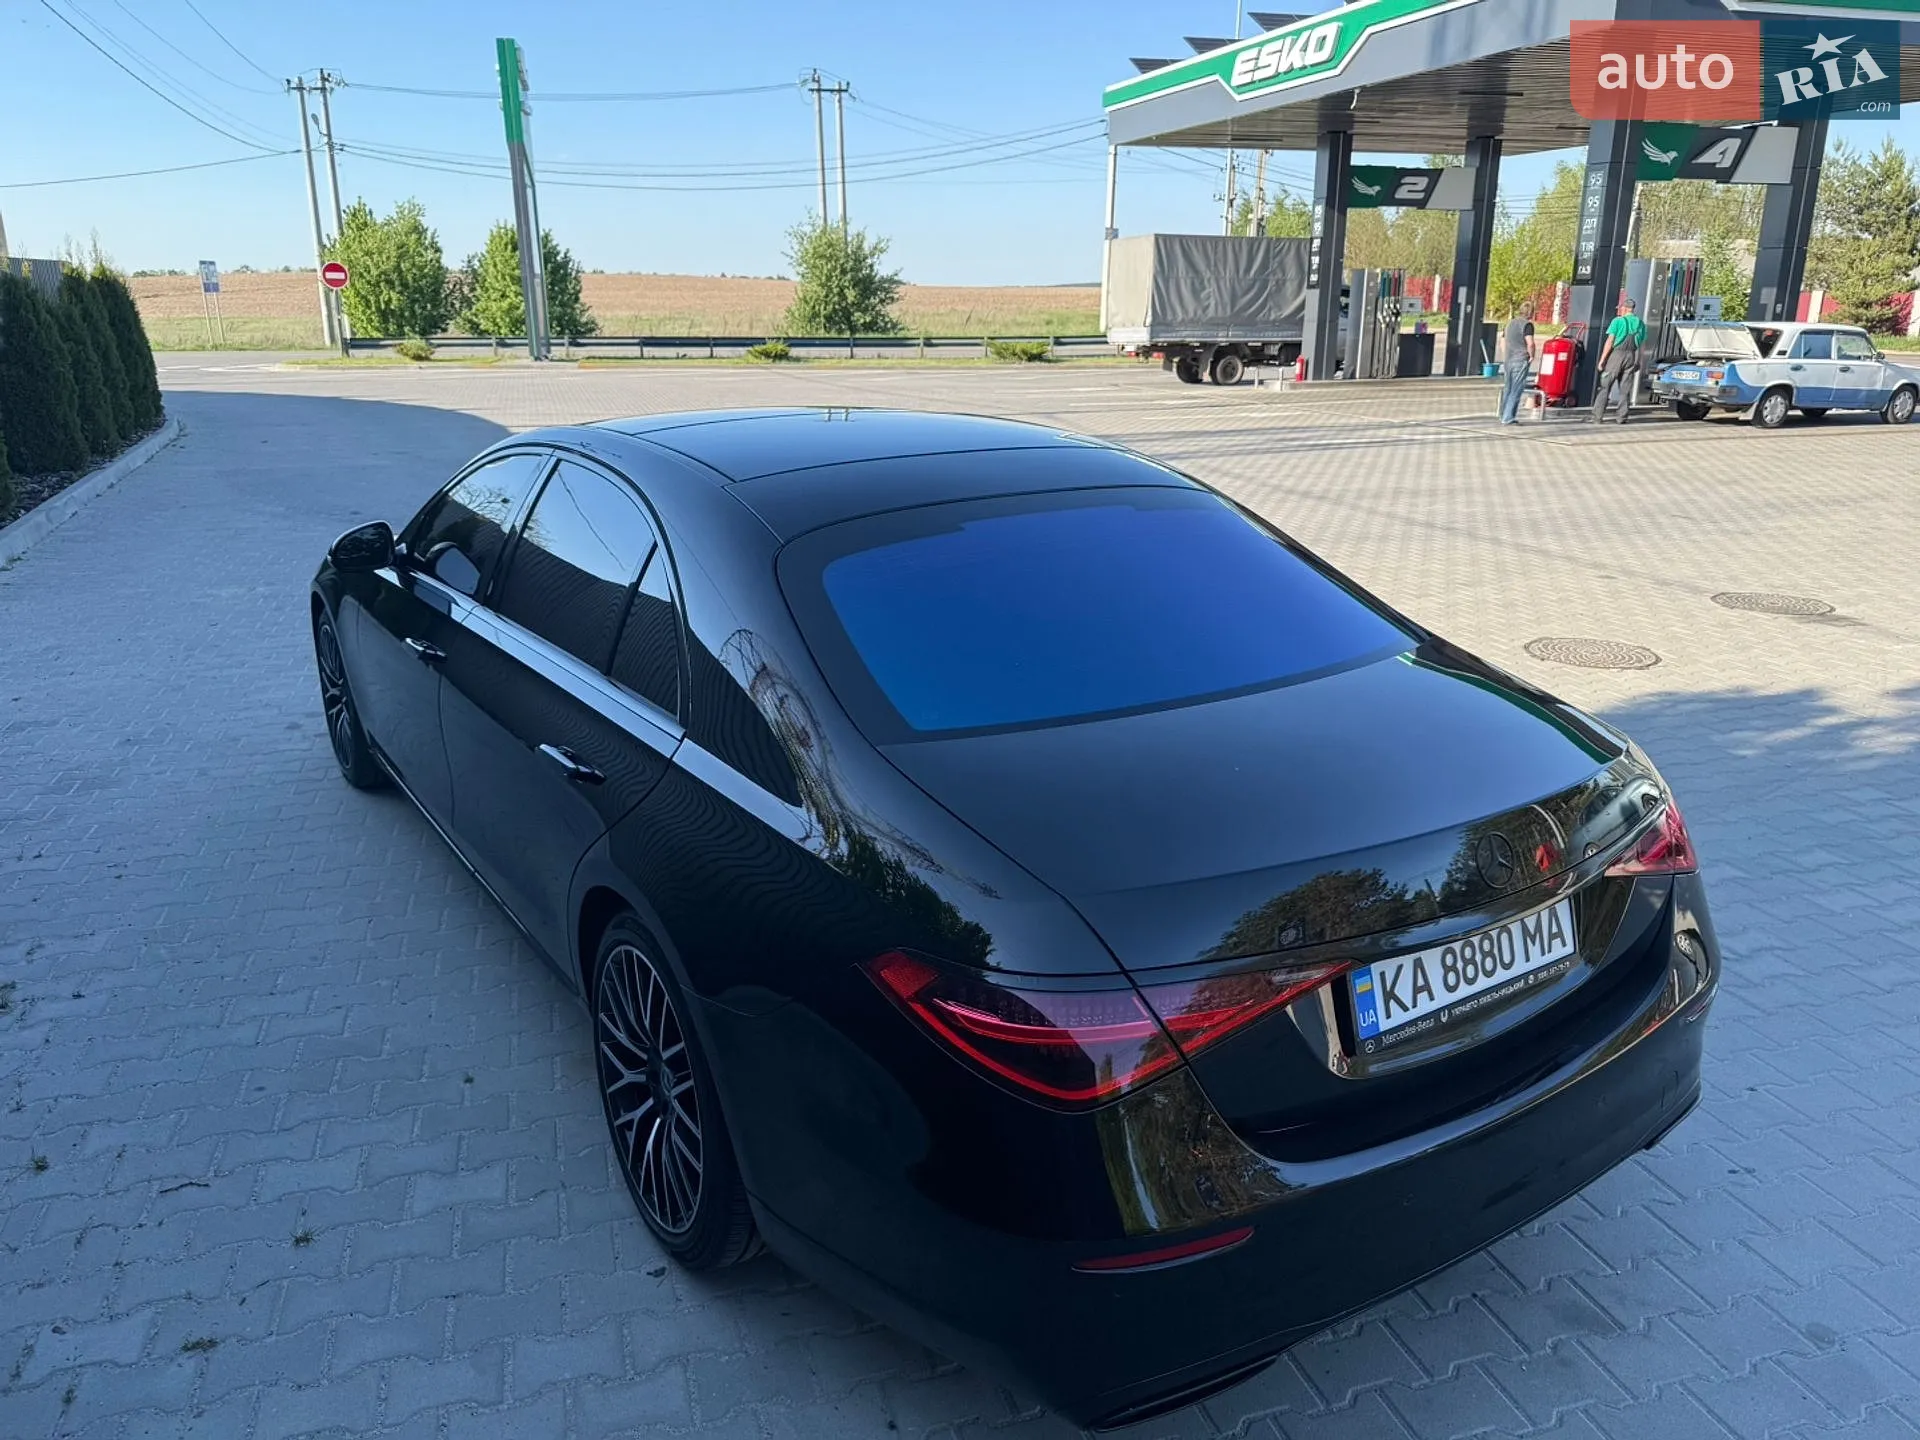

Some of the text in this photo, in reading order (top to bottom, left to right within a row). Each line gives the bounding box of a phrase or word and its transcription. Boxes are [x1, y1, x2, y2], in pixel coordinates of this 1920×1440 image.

[1231, 22, 1342, 87] ESKO
[1691, 138, 1742, 168] 4
[1394, 176, 1429, 199] 2
[1588, 196, 1600, 207] 95
[1380, 957, 1435, 1019] KA
[1441, 924, 1516, 993] 8880
[1519, 906, 1567, 963] MA
[1360, 1009, 1377, 1027] UA
